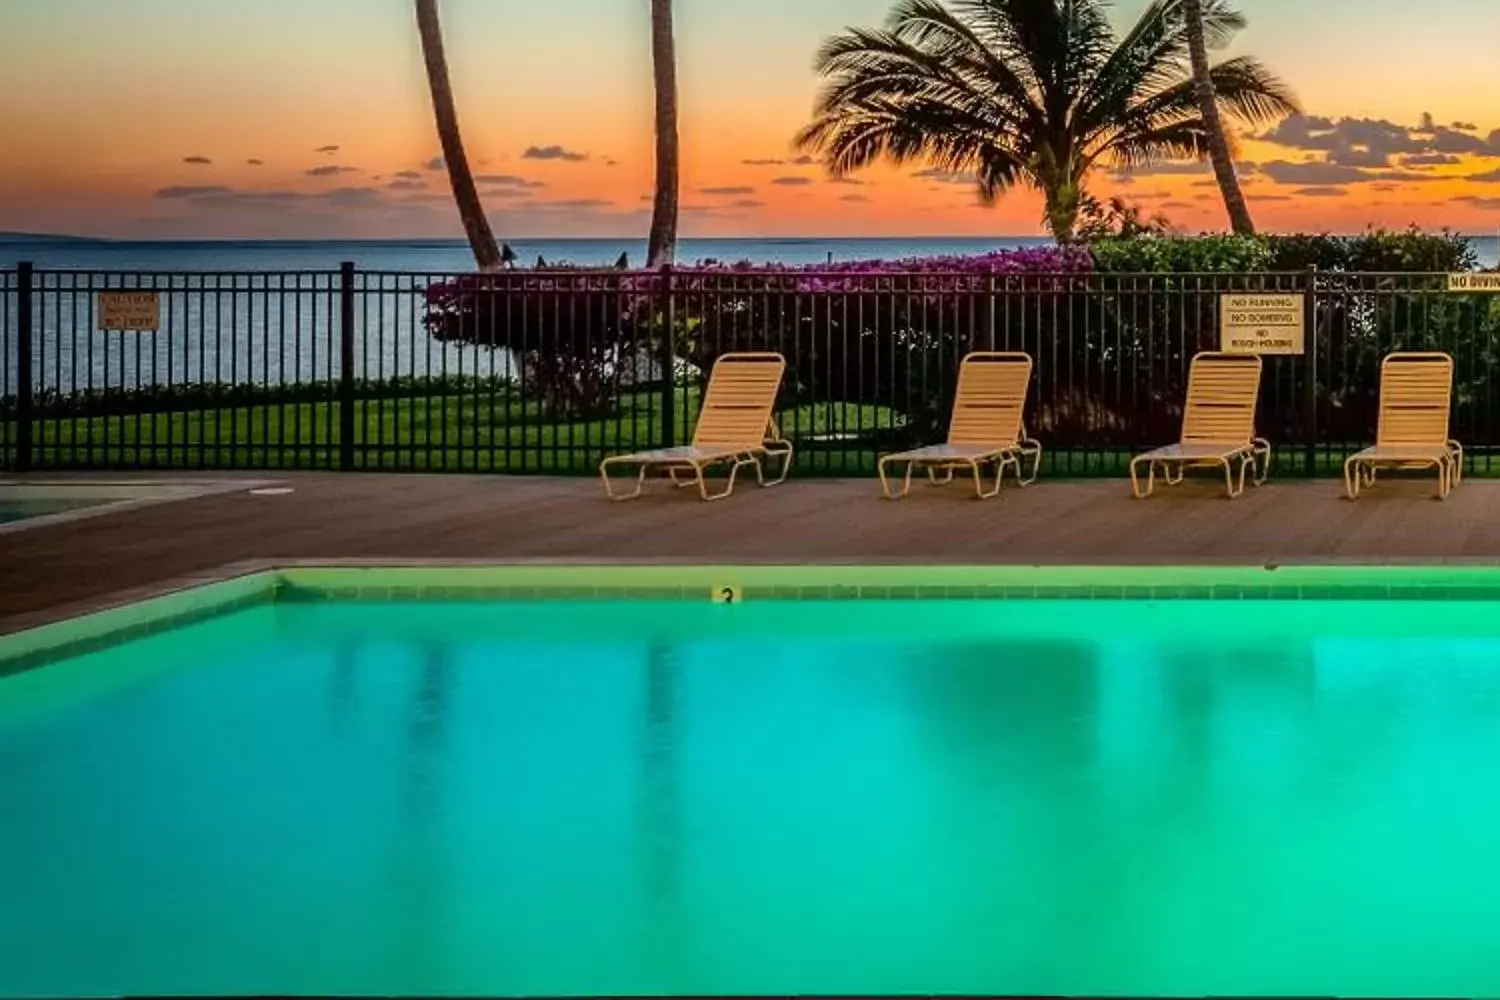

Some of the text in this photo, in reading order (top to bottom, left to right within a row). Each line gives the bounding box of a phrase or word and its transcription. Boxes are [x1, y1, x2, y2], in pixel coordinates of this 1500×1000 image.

[1451, 276, 1466, 288] NO
[1231, 299, 1293, 307] NO RUNNING
[1231, 313, 1247, 322] NO
